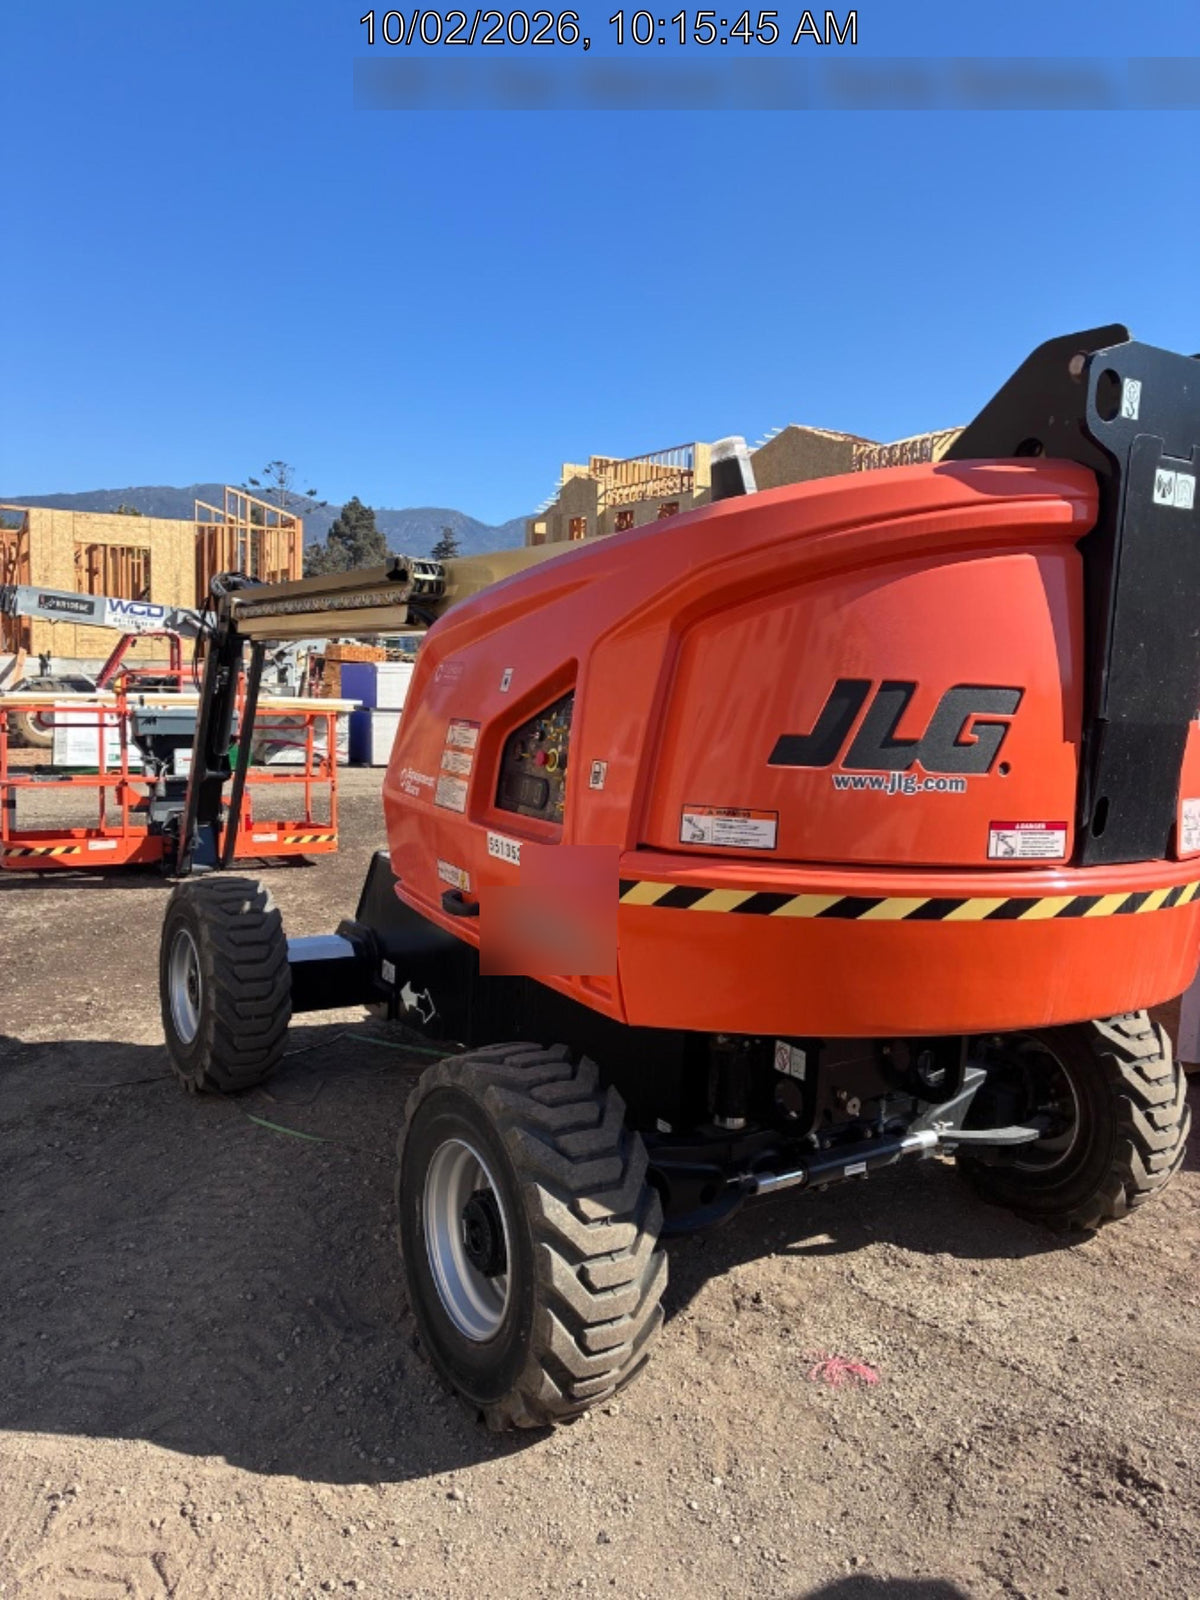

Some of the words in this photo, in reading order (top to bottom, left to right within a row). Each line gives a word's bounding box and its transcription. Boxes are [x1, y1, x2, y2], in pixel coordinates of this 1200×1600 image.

[109, 600, 164, 618] WCD
[767, 678, 1025, 775] JLG
[832, 770, 967, 795] www.jlg.com
